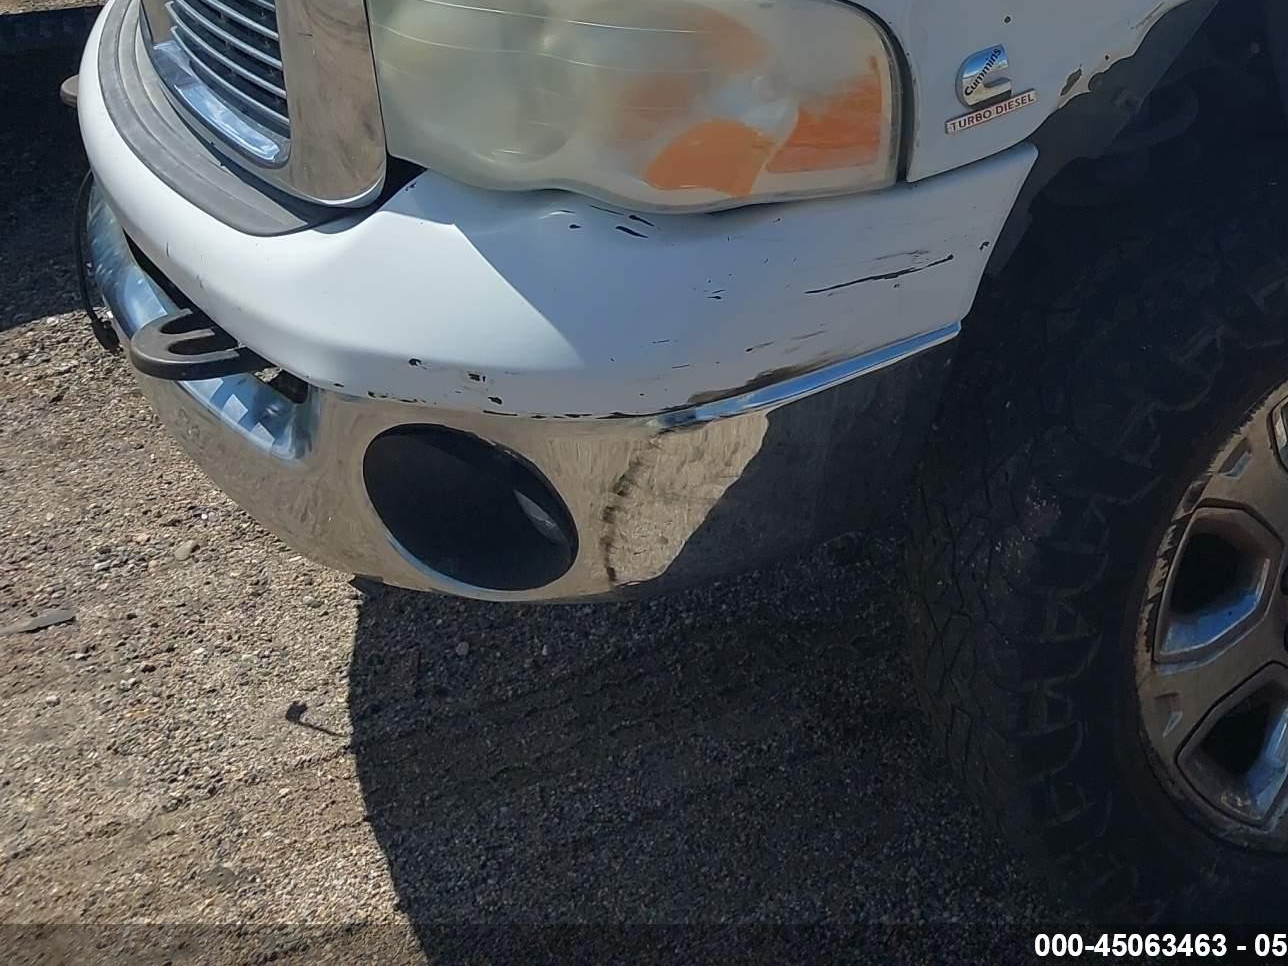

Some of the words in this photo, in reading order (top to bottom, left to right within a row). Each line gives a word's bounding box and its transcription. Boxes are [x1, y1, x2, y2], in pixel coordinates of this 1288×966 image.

[964, 47, 1003, 97] Cummins
[950, 109, 993, 132] TURBO
[995, 93, 1035, 115] DIESEL
